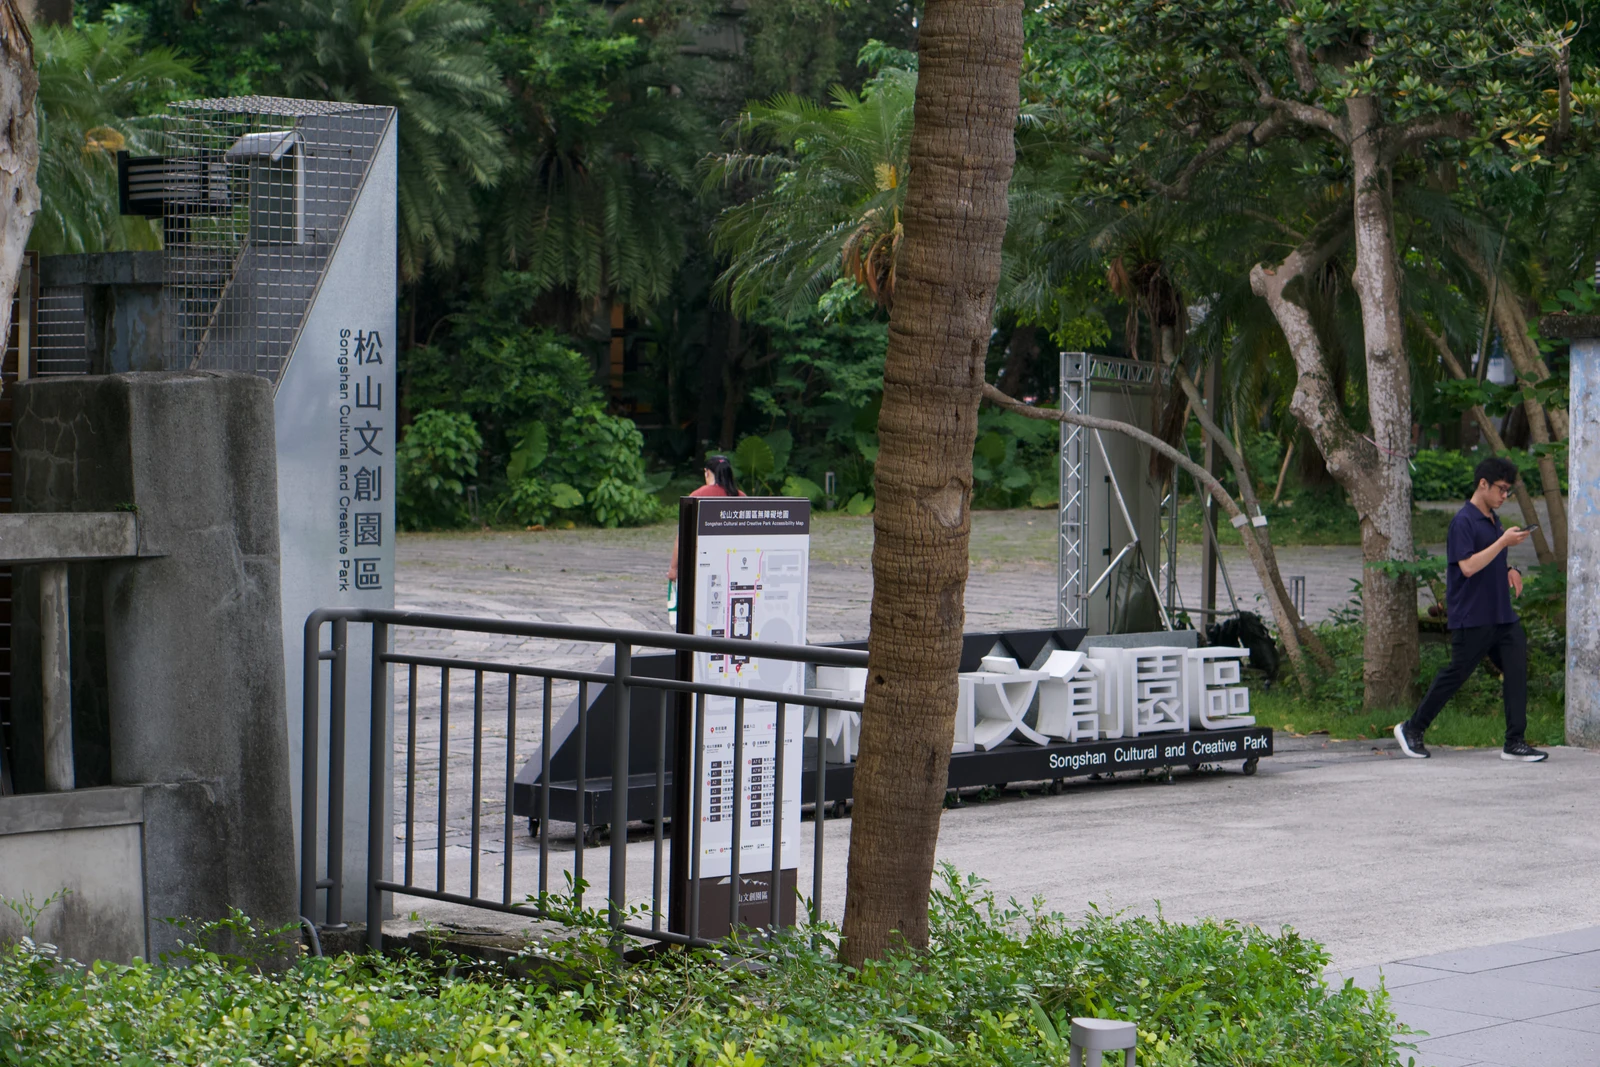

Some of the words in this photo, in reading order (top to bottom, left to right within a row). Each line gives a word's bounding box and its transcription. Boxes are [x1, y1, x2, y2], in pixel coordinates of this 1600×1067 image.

[338, 329, 350, 399] Songshan
[340, 405, 350, 459] Cultural
[339, 465, 350, 490] and
[354, 329, 383, 590] 松山文創園區
[339, 496, 350, 554] Creative
[339, 560, 350, 591] Park
[1049, 752, 1107, 770] Songshan
[1114, 745, 1157, 762] Cultural
[1165, 742, 1186, 758] and
[1192, 738, 1237, 755] Creative
[1243, 734, 1268, 750] Park
